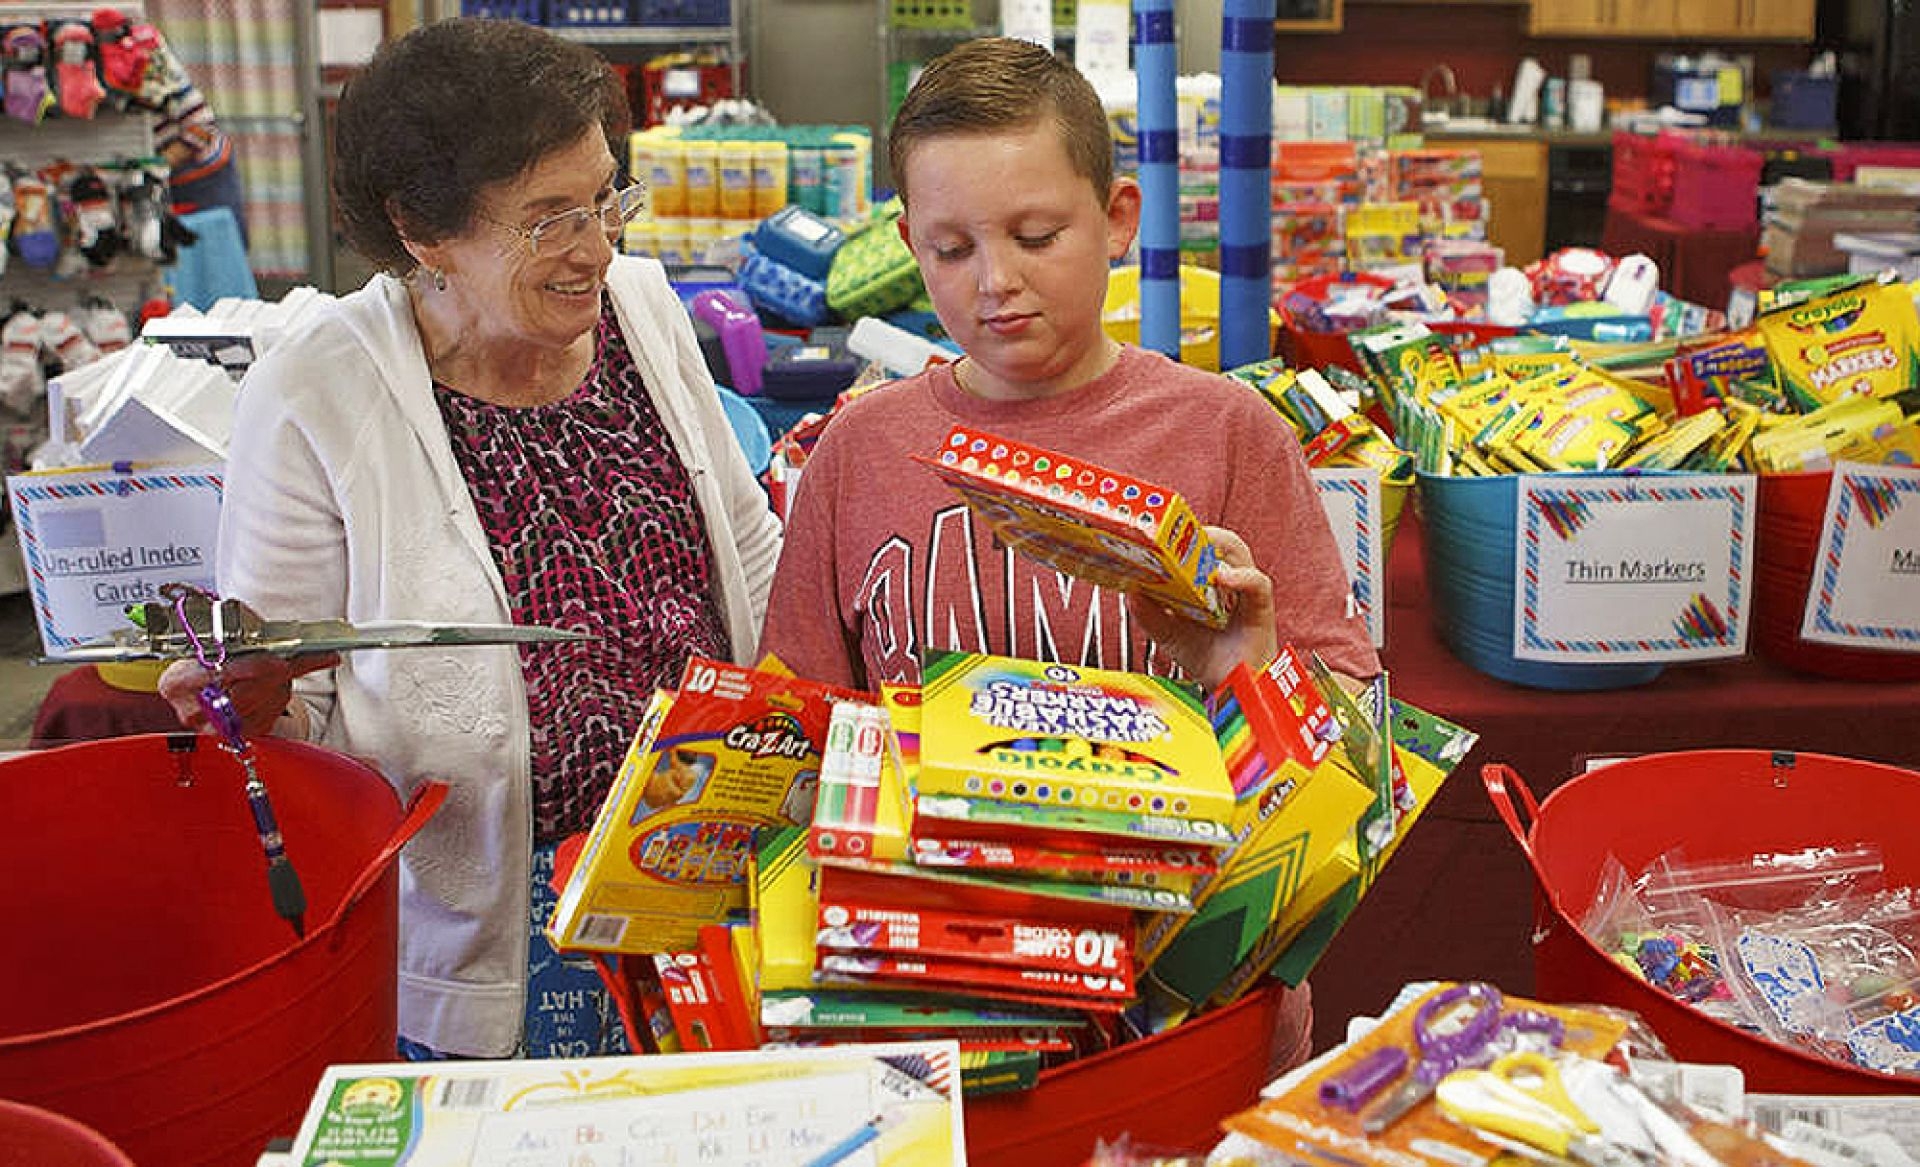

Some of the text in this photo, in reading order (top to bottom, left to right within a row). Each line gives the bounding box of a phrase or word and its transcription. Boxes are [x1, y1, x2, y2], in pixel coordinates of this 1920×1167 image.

[44, 543, 202, 572] Un-ruled Index
[1566, 558, 1706, 580] Thin Markers
[95, 579, 154, 601] Cards
[684, 665, 717, 693] 10
[988, 681, 1138, 714] MARKERS
[969, 690, 1168, 737] WASHABLE
[995, 750, 1164, 781] Crayola
[1075, 929, 1120, 968] 10
[540, 989, 585, 1011] HAT
